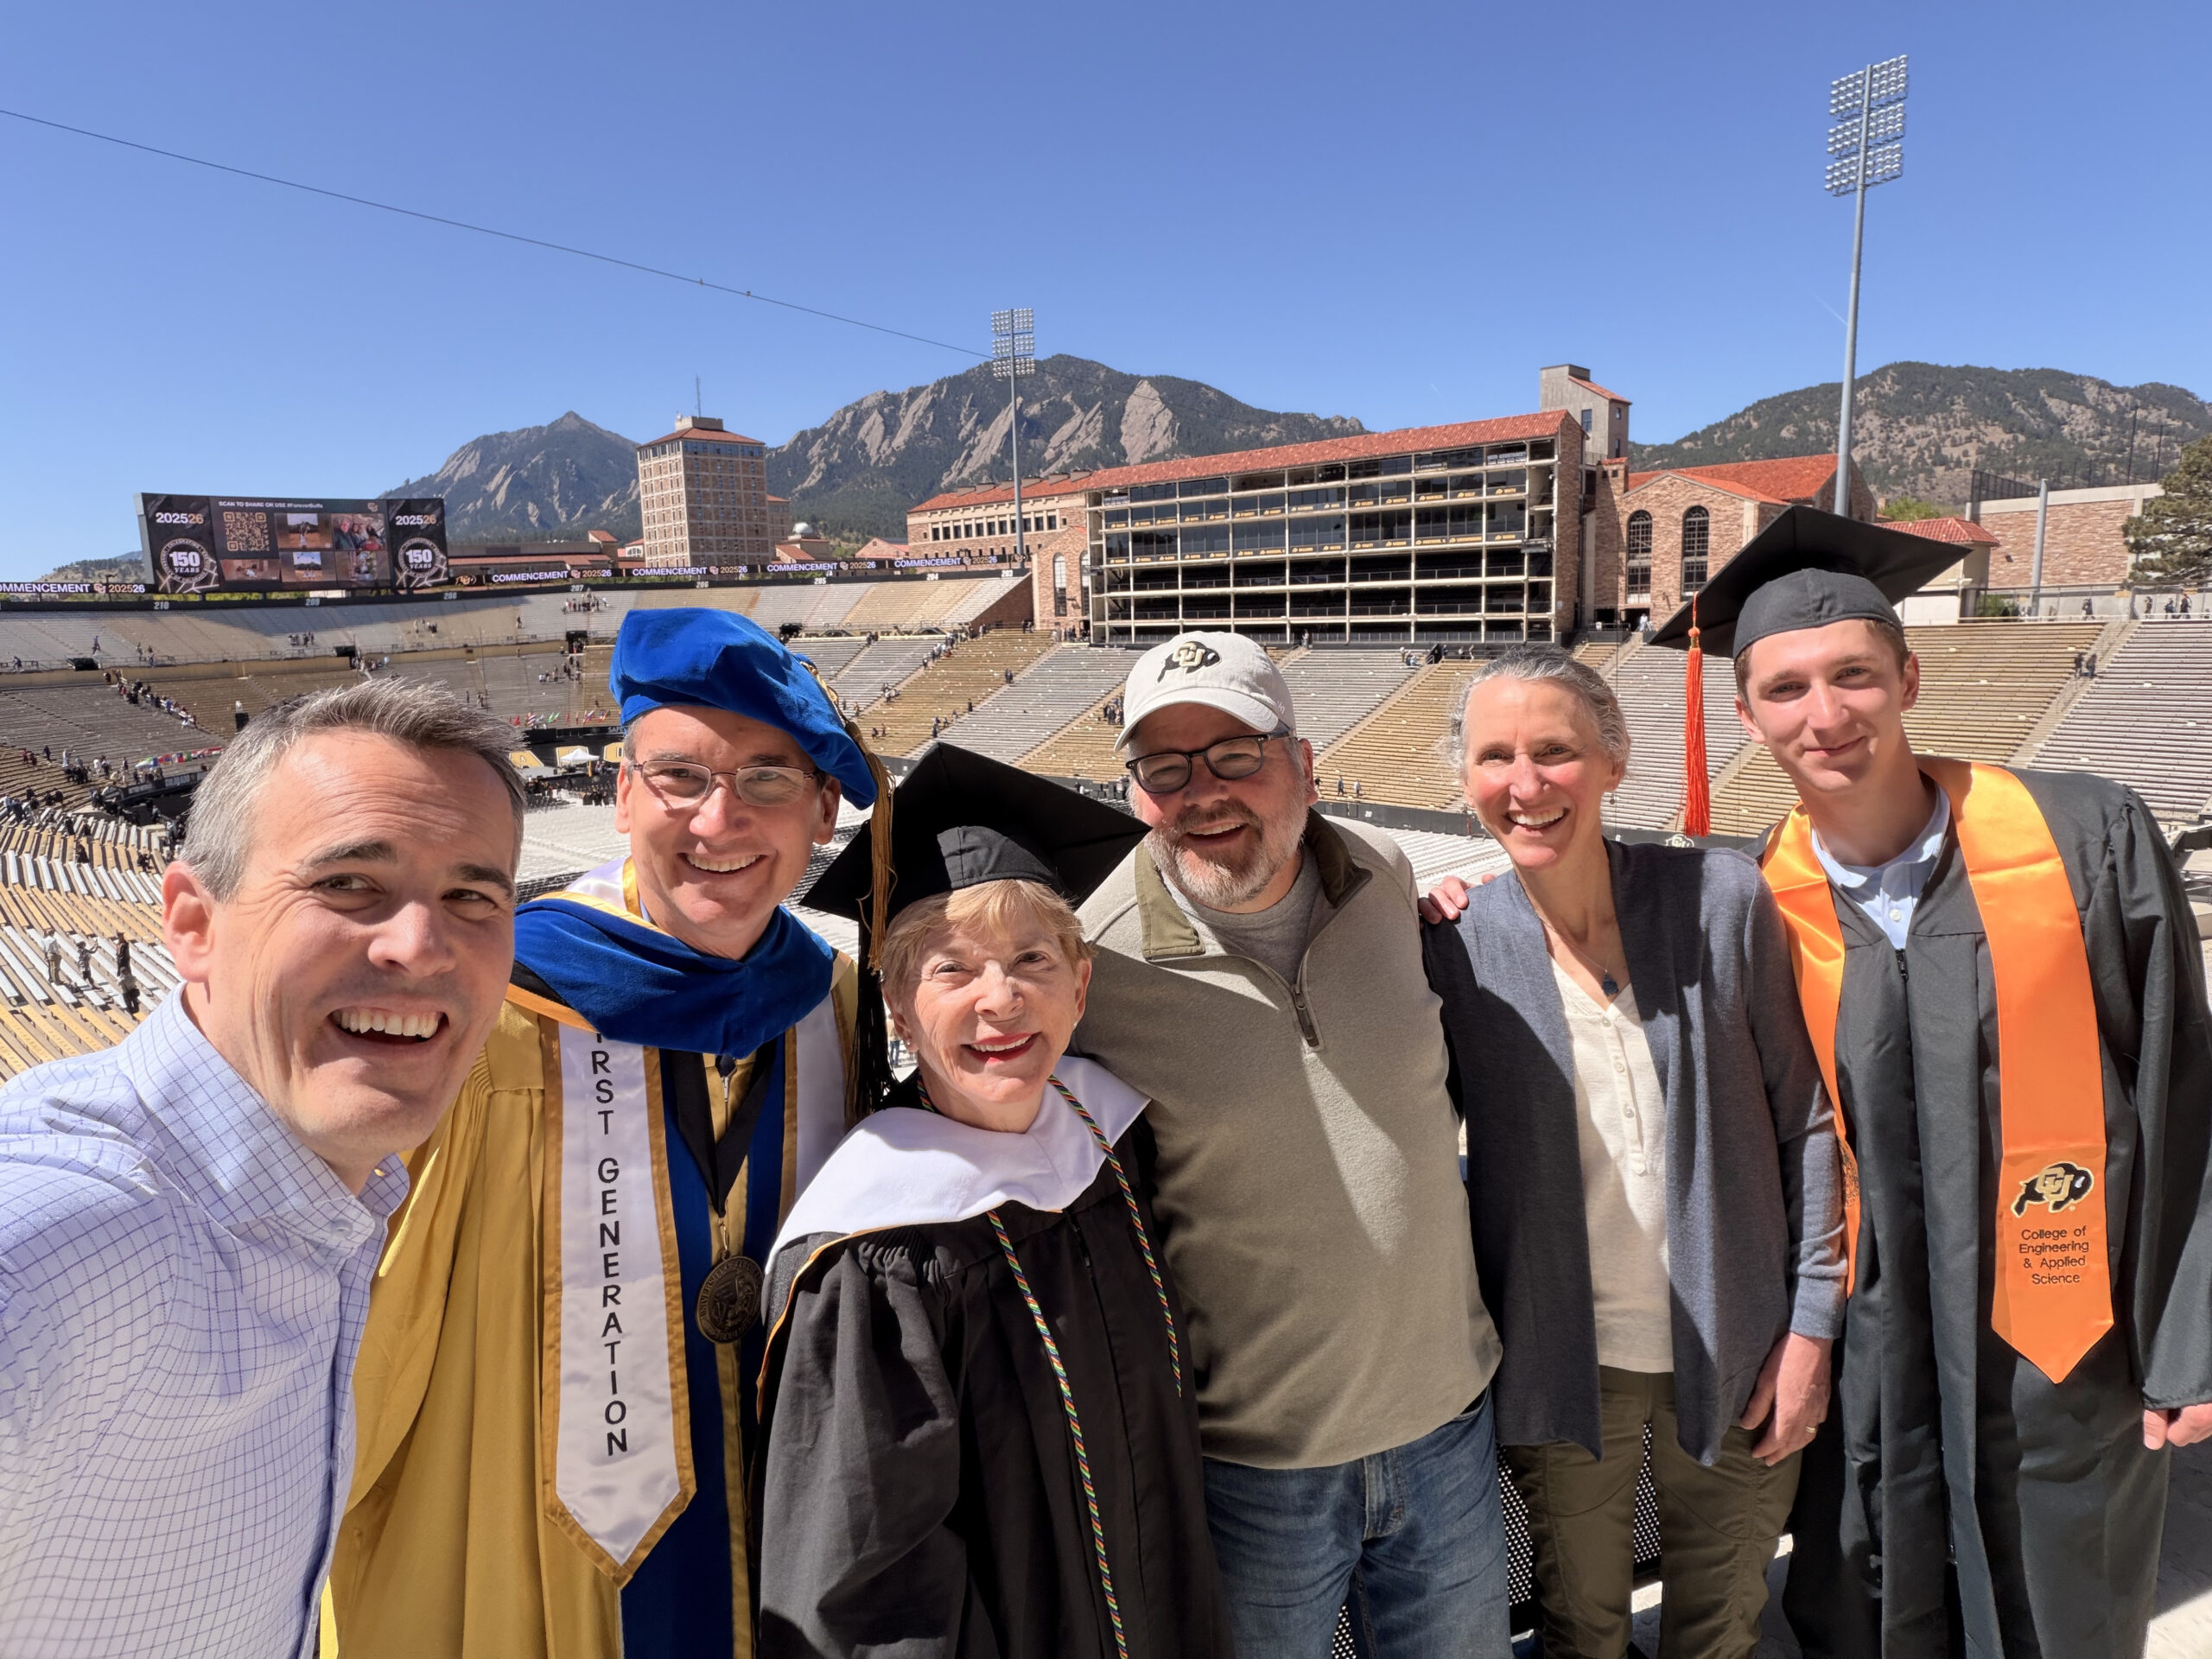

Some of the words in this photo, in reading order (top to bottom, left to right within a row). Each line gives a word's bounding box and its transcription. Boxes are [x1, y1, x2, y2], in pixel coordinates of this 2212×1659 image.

[168, 551, 200, 567] 150
[405, 549, 433, 563] 150
[894, 557, 961, 568] COMMENCEMENT
[632, 567, 708, 576] COMMENCEMENT
[766, 563, 838, 572] COMMENCEMENT
[492, 570, 569, 583] COMMENCEMENT
[1172, 642, 1205, 667] CU
[2035, 1166, 2075, 1202] CU
[2021, 1229, 2068, 1241] College
[2074, 1225, 2087, 1236] of
[2019, 1241, 2089, 1255] Engineering
[2023, 1257, 2032, 1268] &
[2040, 1255, 2086, 1270] Applied
[2031, 1273, 2080, 1285] Science
[598, 1157, 628, 1457] GENERATION
